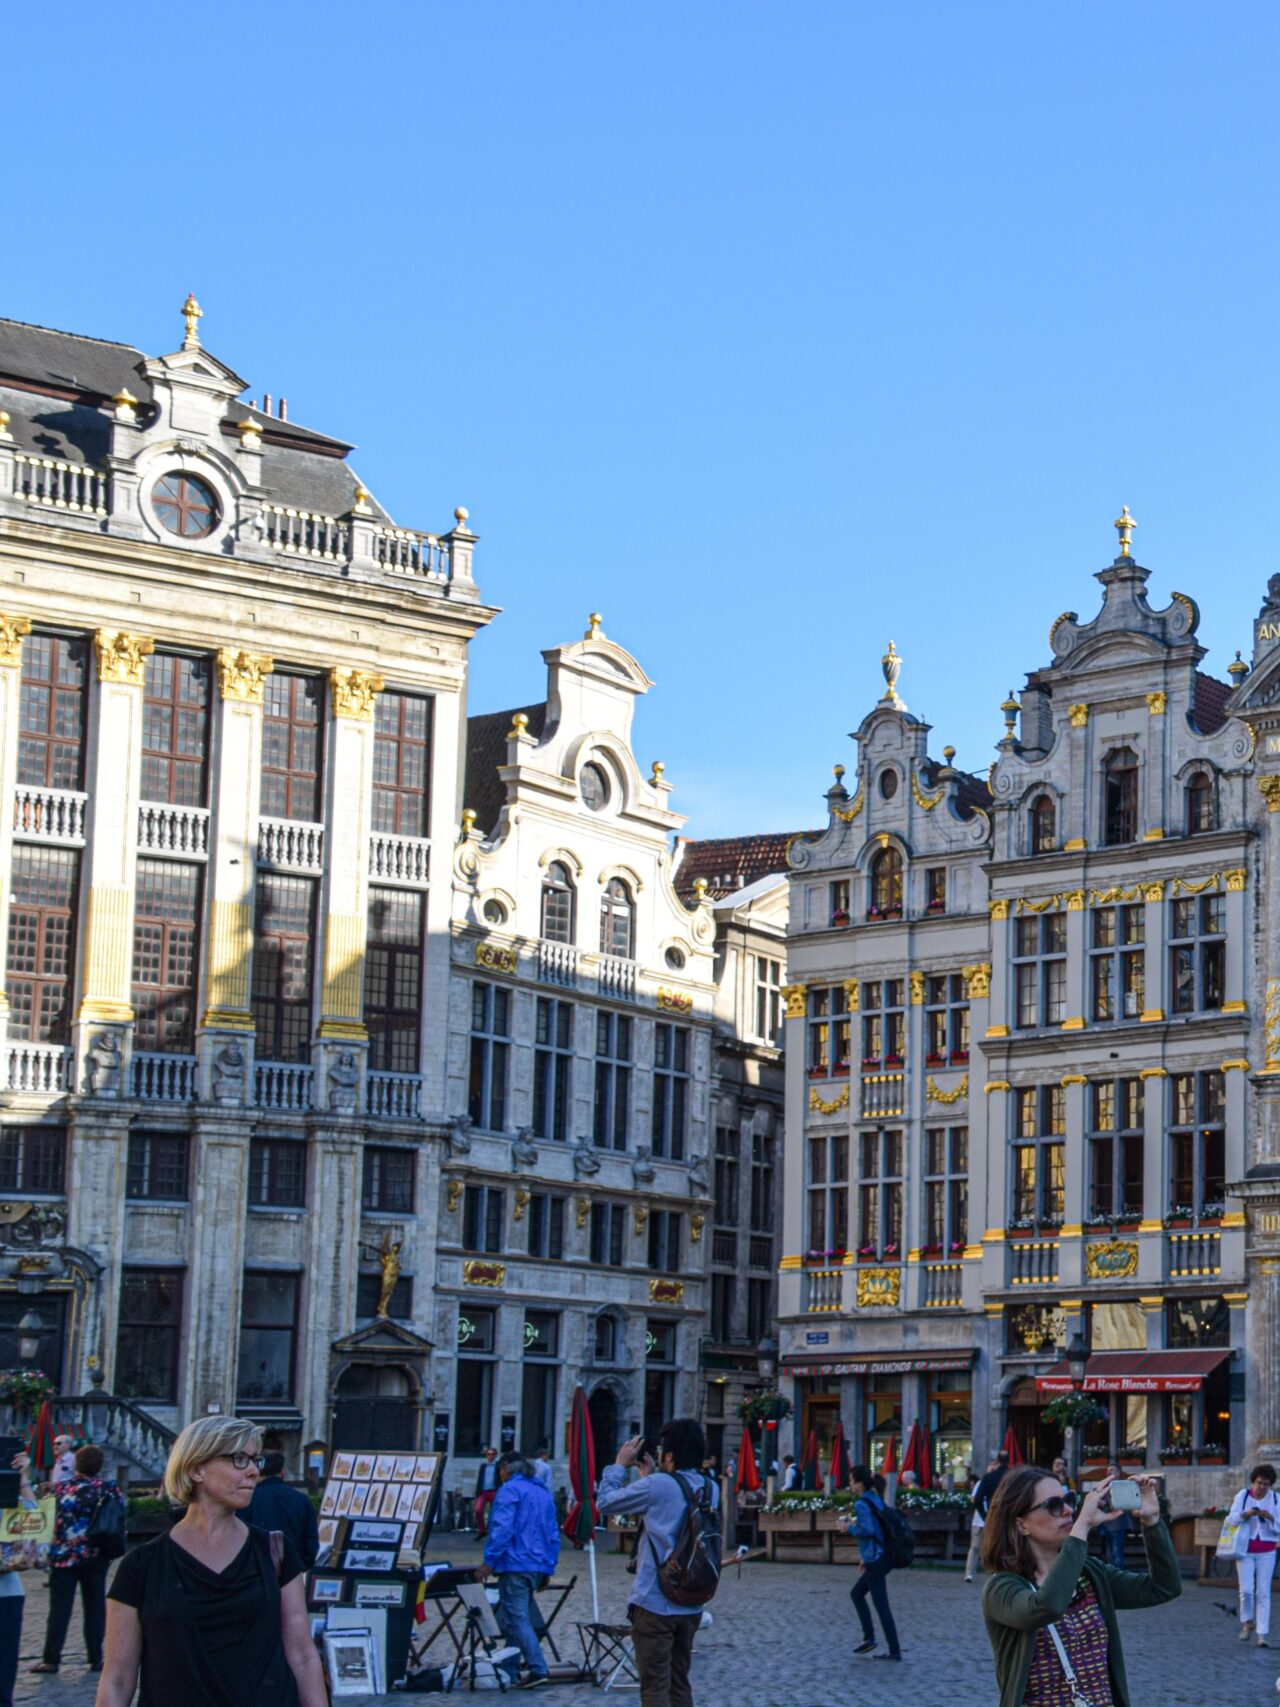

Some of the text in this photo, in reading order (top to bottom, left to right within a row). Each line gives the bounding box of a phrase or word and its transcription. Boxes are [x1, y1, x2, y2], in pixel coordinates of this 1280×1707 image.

[834, 1362, 867, 1375] GAUTAM
[870, 1361, 912, 1374] DIAMONDS
[1082, 1378, 1158, 1390] La Rose Blanche
